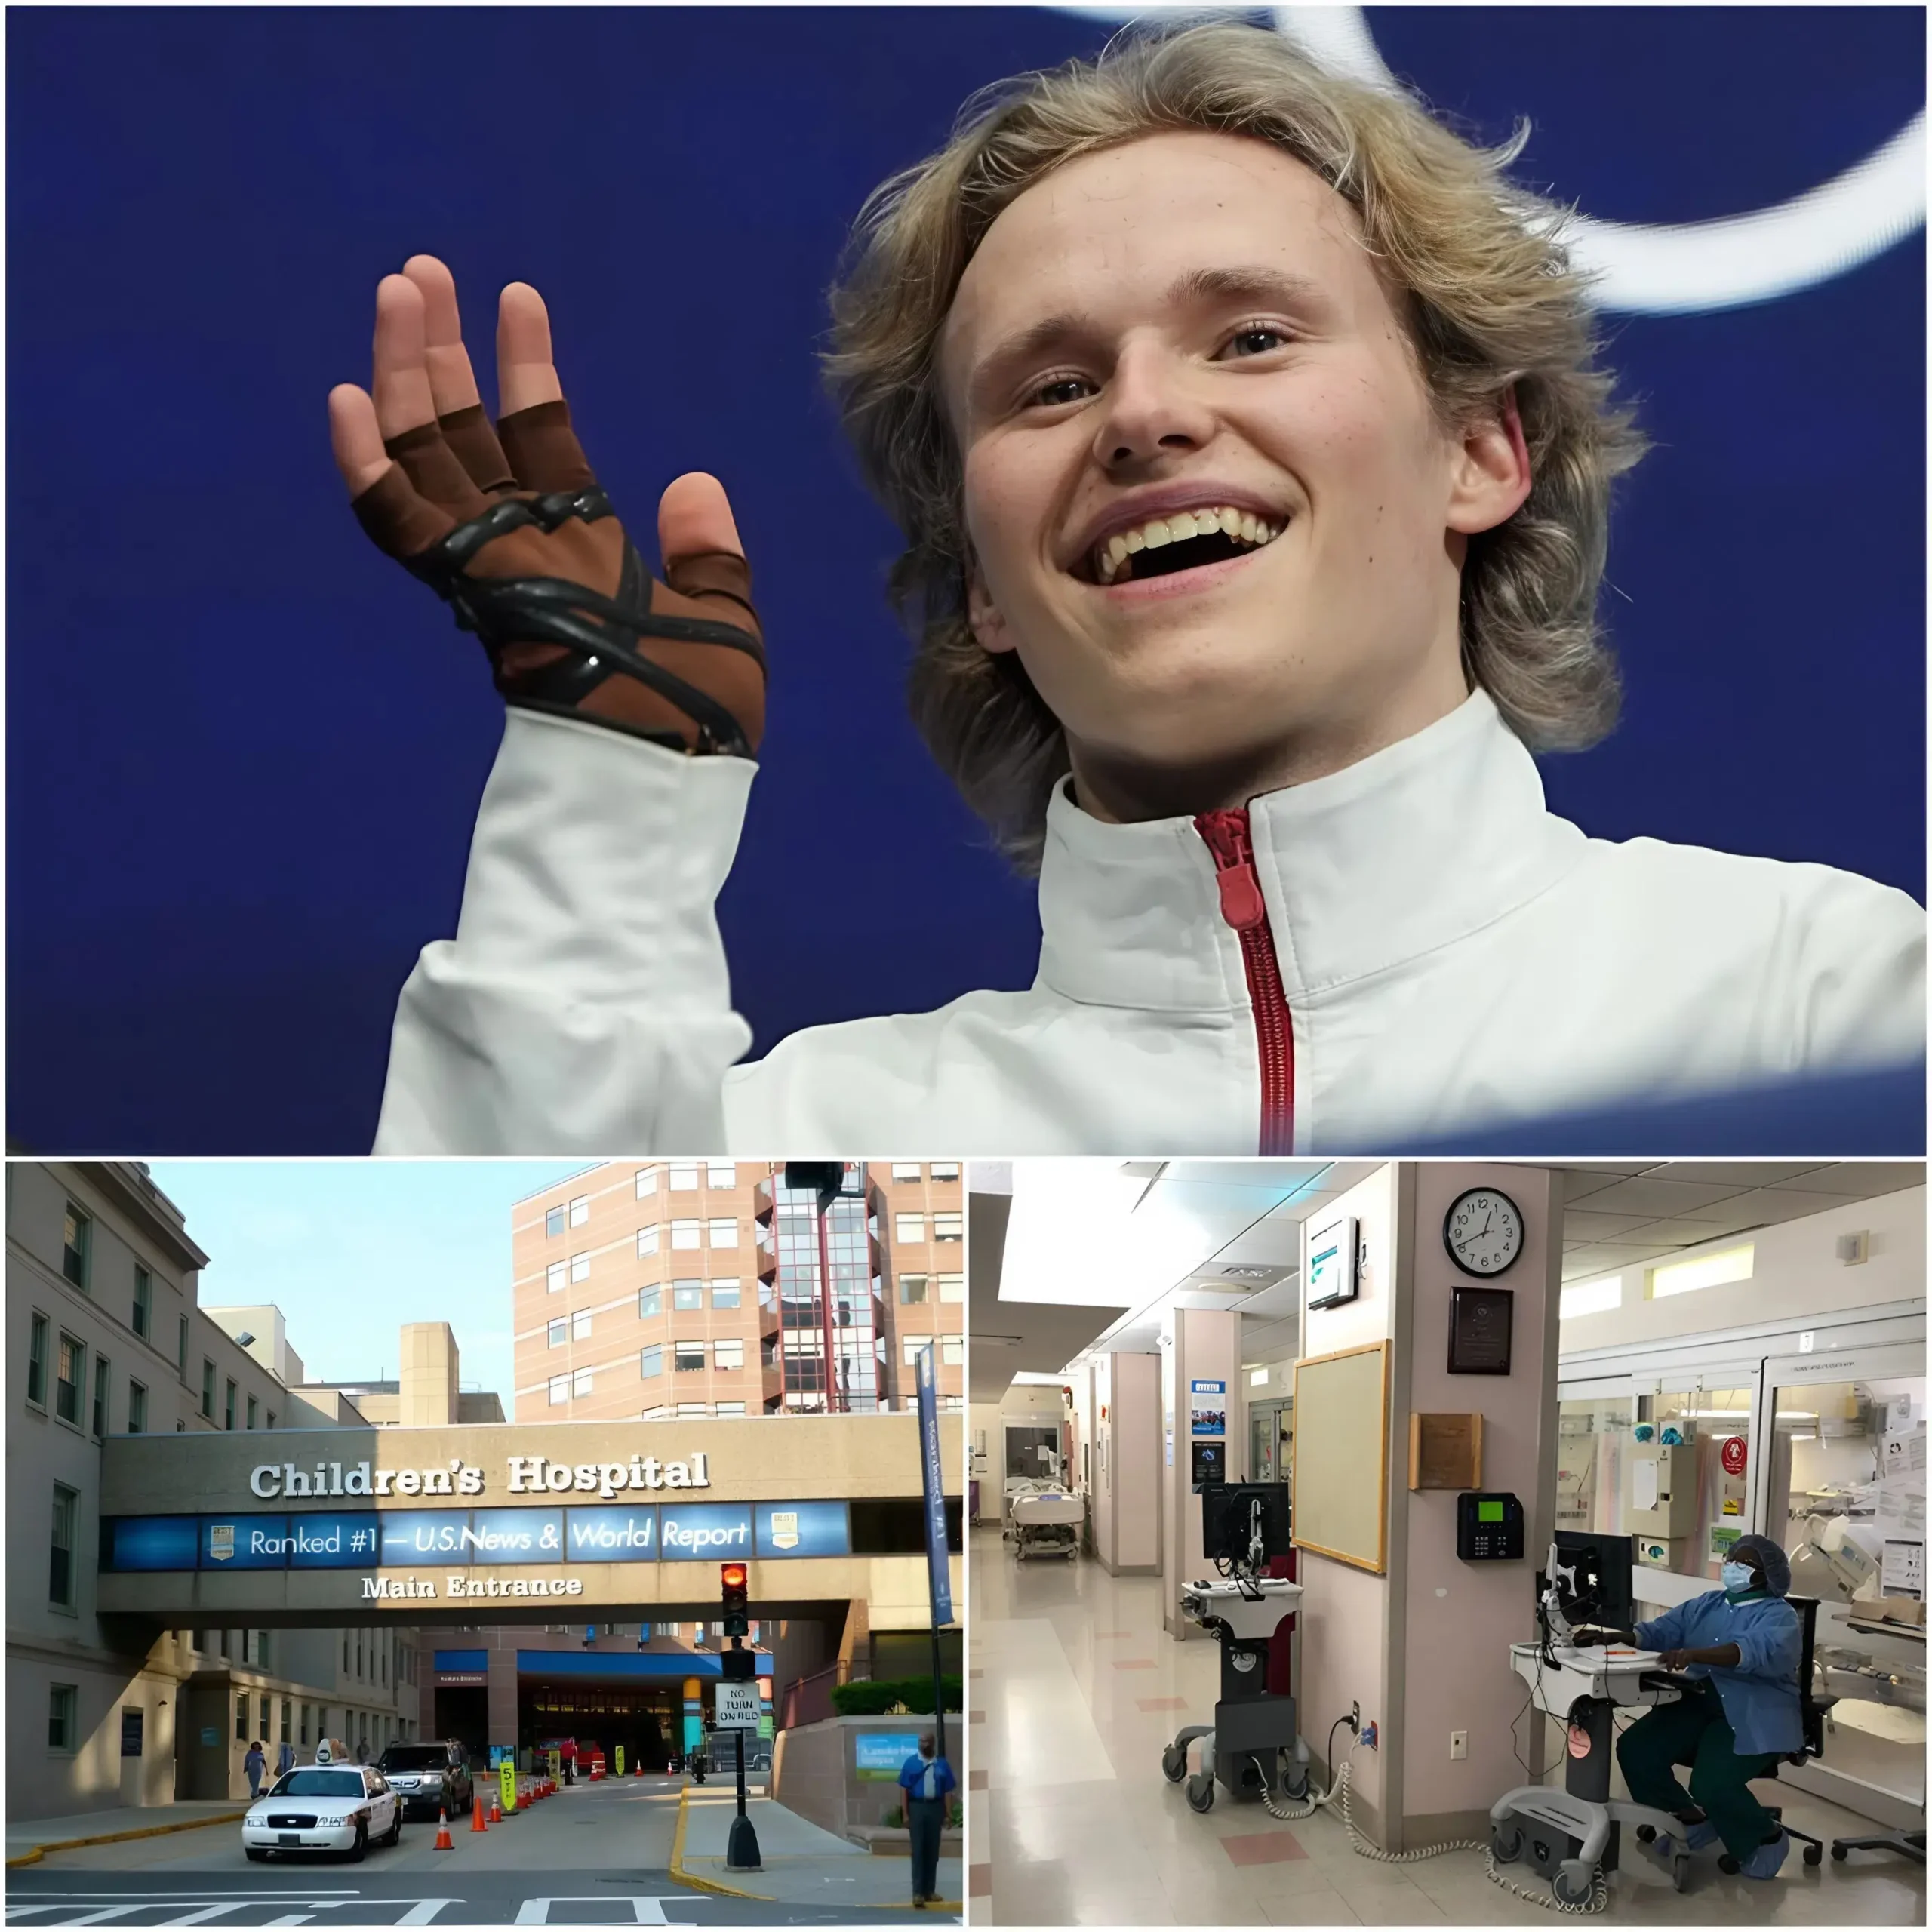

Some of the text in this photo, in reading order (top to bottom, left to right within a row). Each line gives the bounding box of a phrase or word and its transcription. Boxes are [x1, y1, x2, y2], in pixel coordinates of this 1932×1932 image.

[1478, 1198, 1488, 1209] 12
[1494, 1204, 1498, 1213] 1
[1467, 1204, 1475, 1214] 11
[1457, 1215, 1469, 1225] 10
[1502, 1214, 1509, 1224] 2
[1506, 1227, 1513, 1238] 3
[1469, 1254, 1475, 1263] 7
[1481, 1257, 1489, 1266] 6
[250, 1452, 710, 1497] Children's Hospital
[251, 1525, 340, 1554] Ranked
[350, 1528, 376, 1552] #1
[539, 1524, 560, 1549] &
[573, 1518, 652, 1548] World
[663, 1521, 750, 1554] Report
[361, 1576, 583, 1598] Main Entrance
[731, 1690, 745, 1698] NO
[720, 1712, 736, 1721] ON
[503, 1768, 512, 1780] 5
